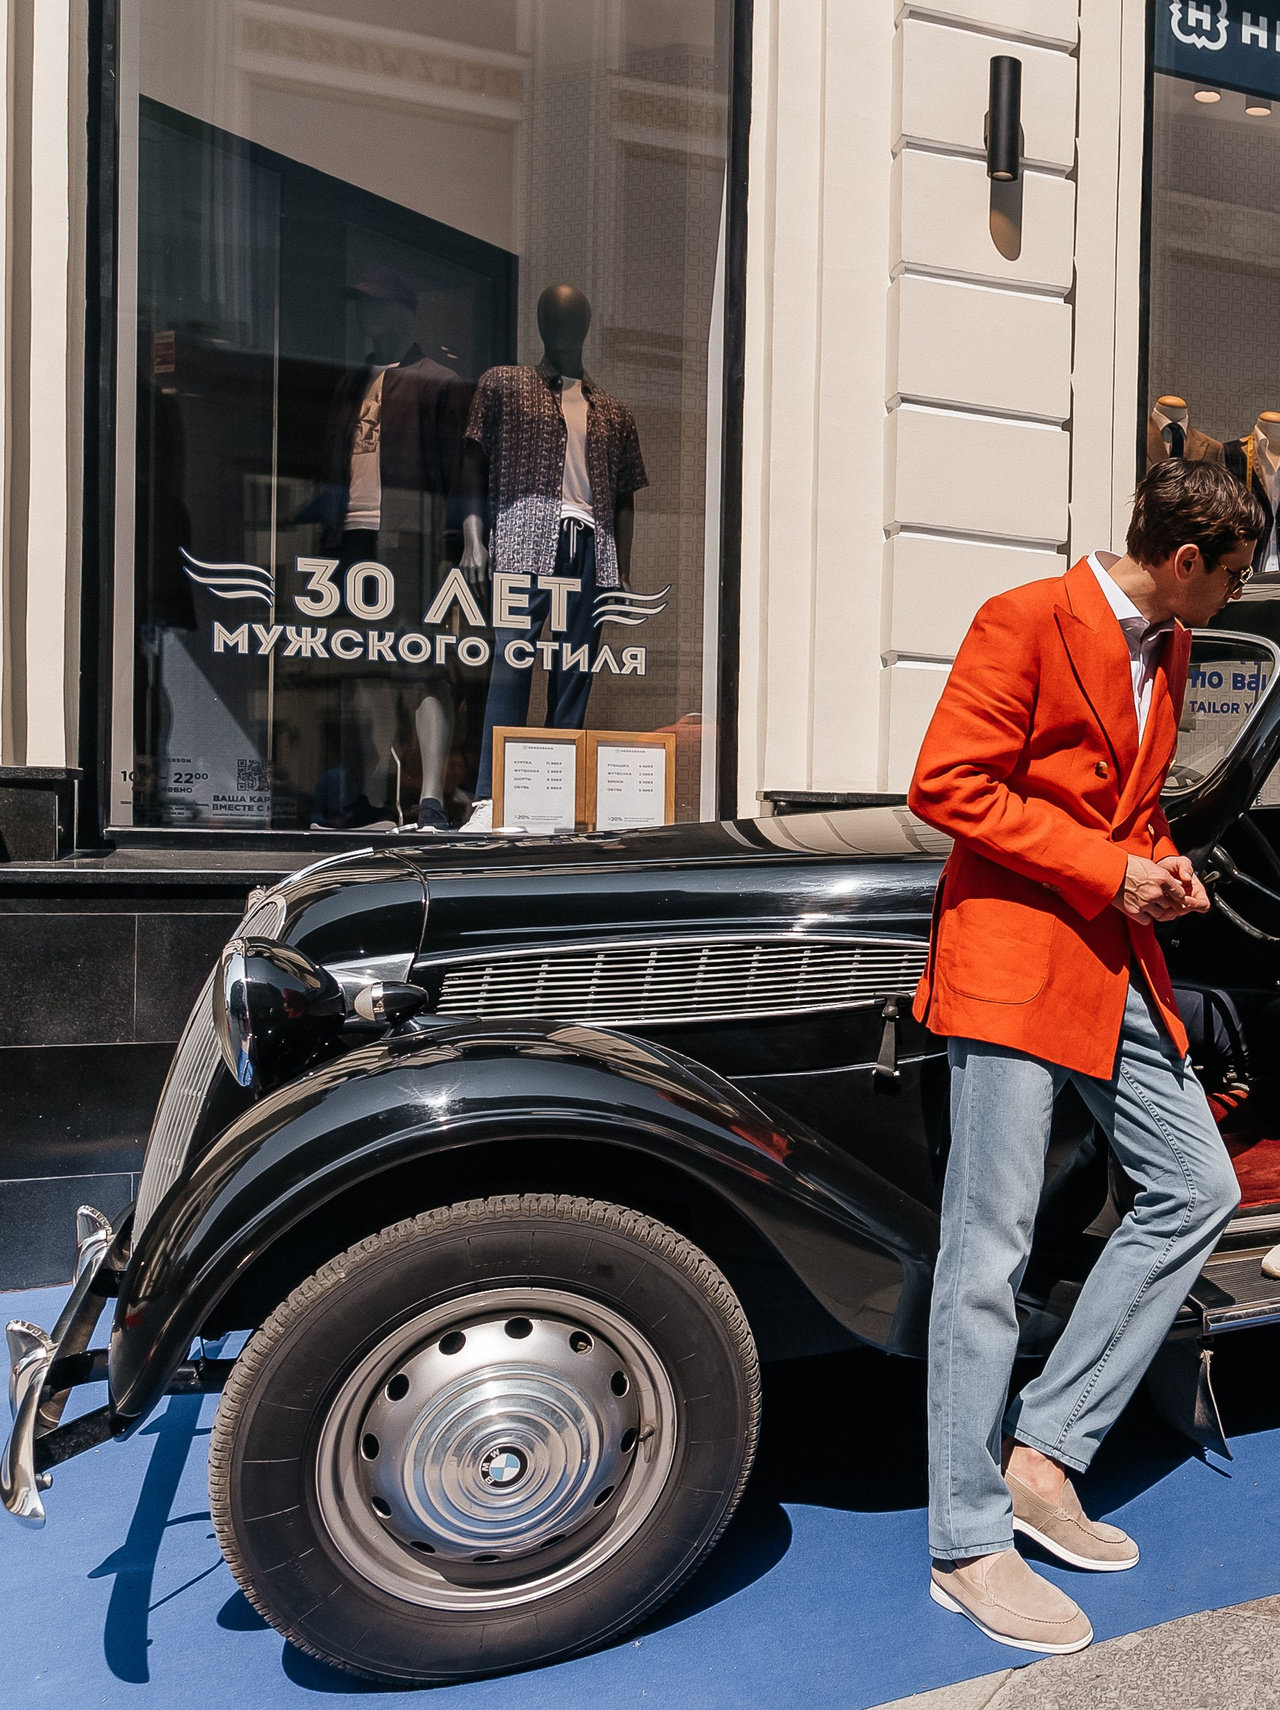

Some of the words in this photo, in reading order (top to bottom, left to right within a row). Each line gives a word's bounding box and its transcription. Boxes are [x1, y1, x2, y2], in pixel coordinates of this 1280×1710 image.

[294, 557, 395, 620] 30
[423, 568, 582, 632] ЛЕТ
[213, 621, 490, 667] МУЖСКОГО
[504, 640, 646, 676] СТИЛЯ
[1189, 700, 1240, 714] TAILOR
[213, 795, 247, 803] ВАША
[481, 1448, 501, 1485] BMW
